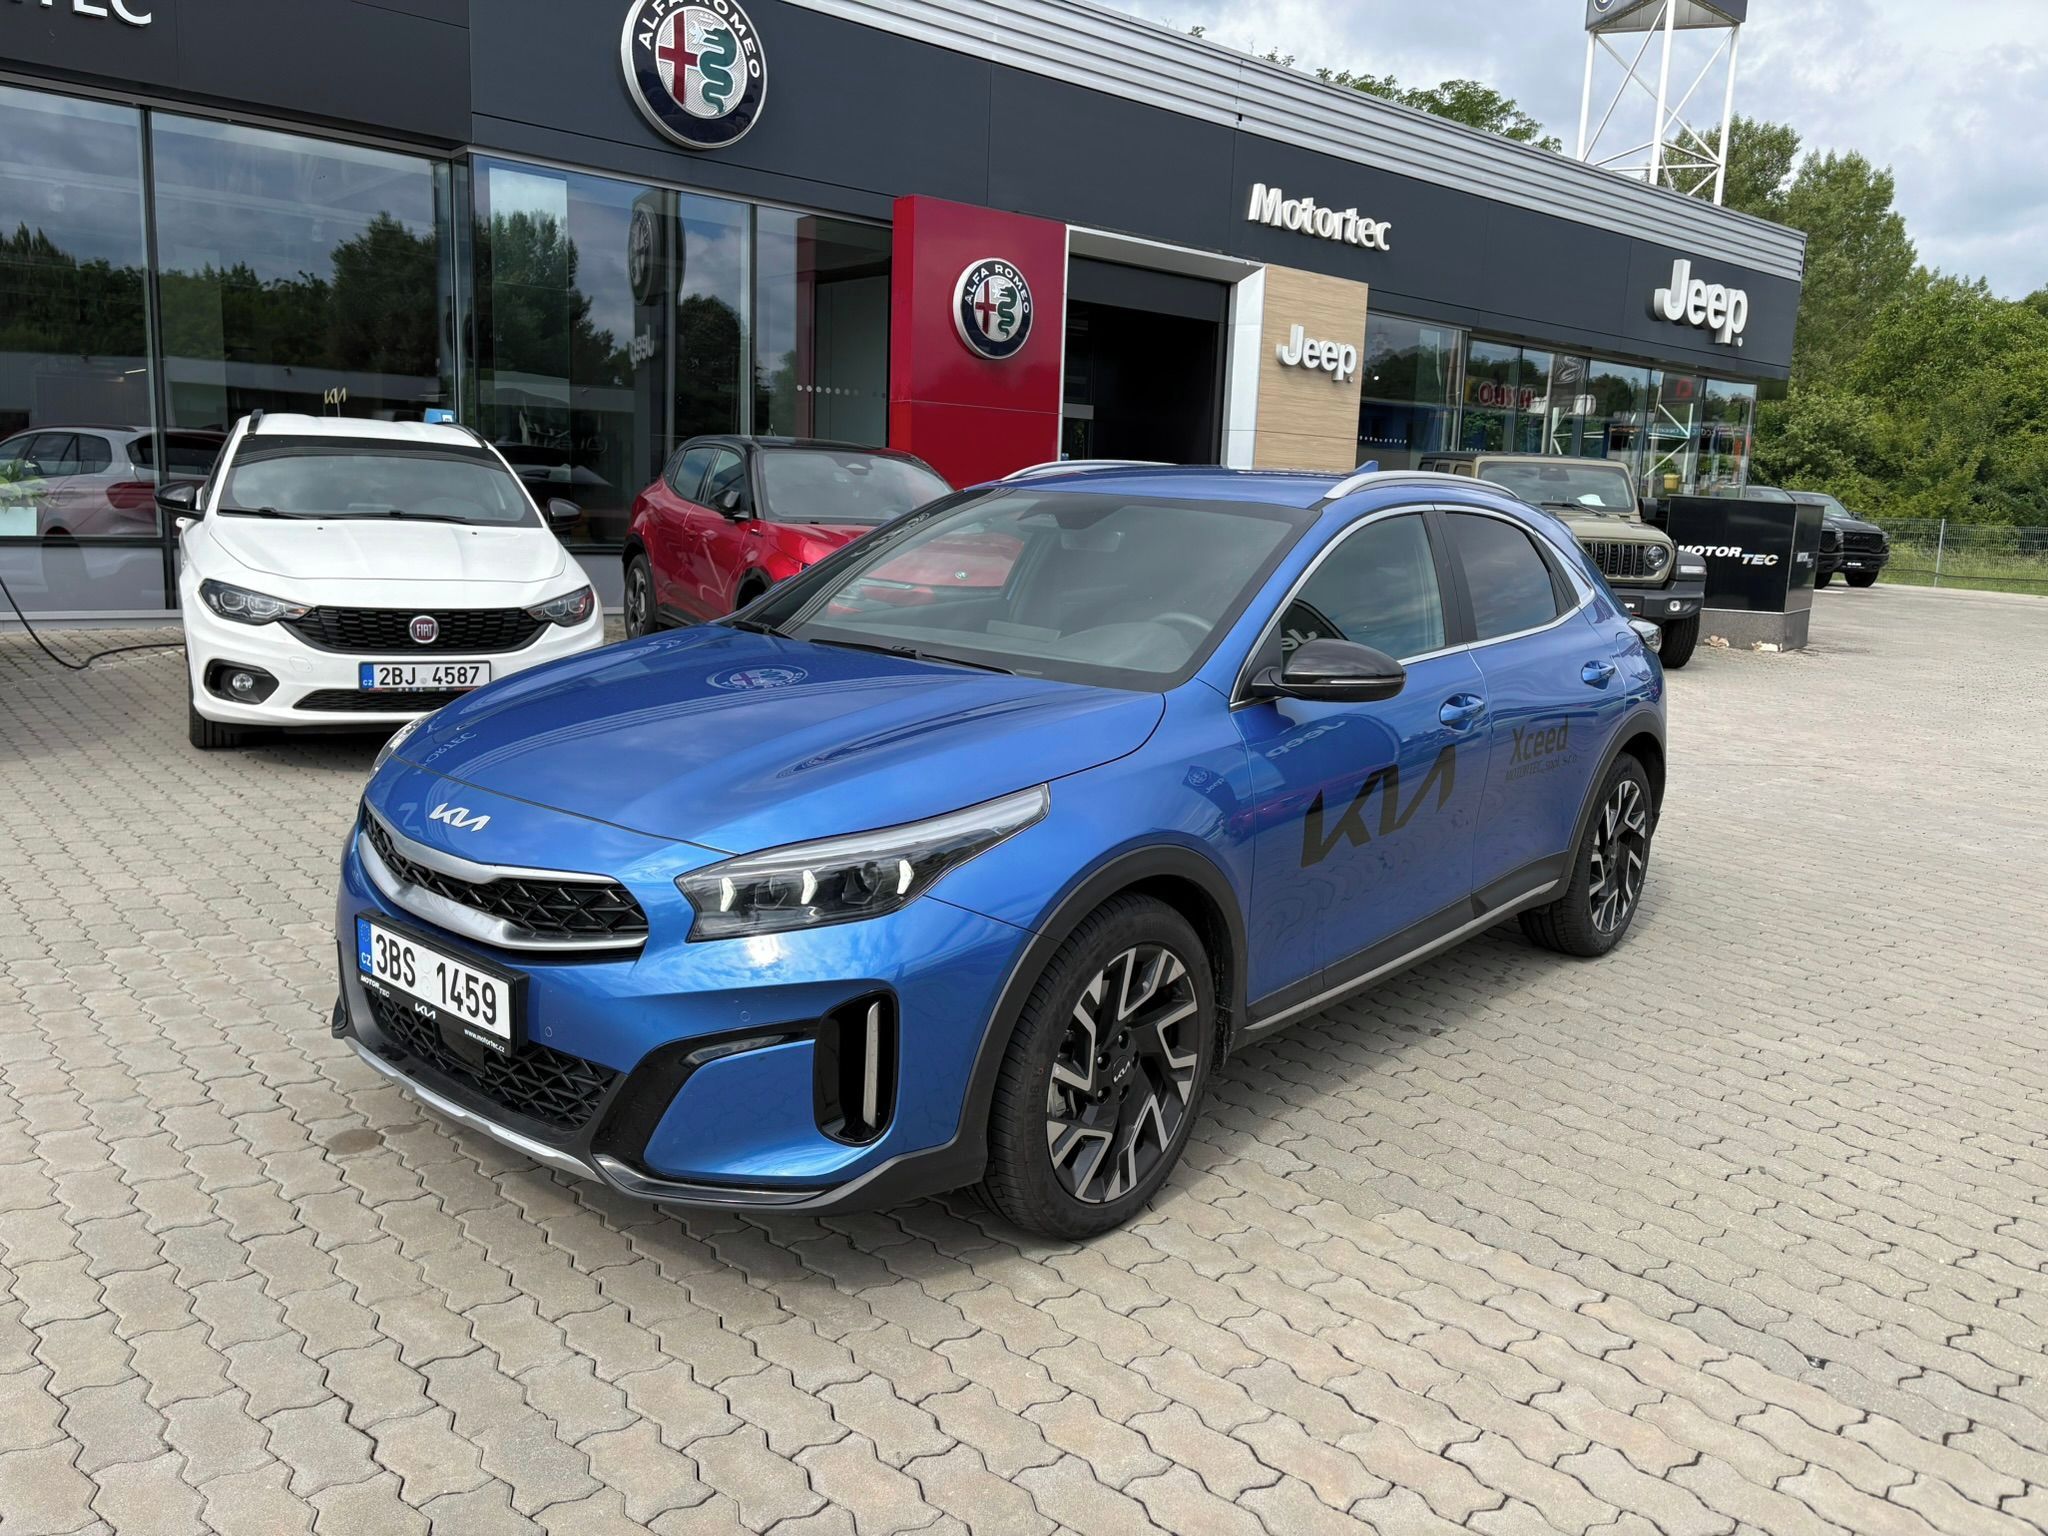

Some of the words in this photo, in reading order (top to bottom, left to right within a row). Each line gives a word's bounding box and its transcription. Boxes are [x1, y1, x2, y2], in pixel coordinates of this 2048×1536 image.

[638, 0, 683, 50] ALF
[697, 0, 761, 78] OMEO
[1247, 182, 1392, 251] Motortec
[964, 267, 989, 305] ALFA
[994, 264, 1030, 313] ROMEO
[1653, 258, 1748, 345] Jeep
[1275, 323, 1357, 381] Jeep
[416, 623, 433, 637] FIAT
[379, 667, 416, 686] 2BJ
[432, 666, 480, 685] 4587
[1509, 712, 1569, 767] Xceed
[429, 802, 492, 832] KIA
[1301, 743, 1457, 869] KIA
[361, 951, 372, 966] CZ
[375, 933, 416, 988] 3BS
[436, 962, 498, 1026] 1459
[414, 1002, 436, 1020] KIA
